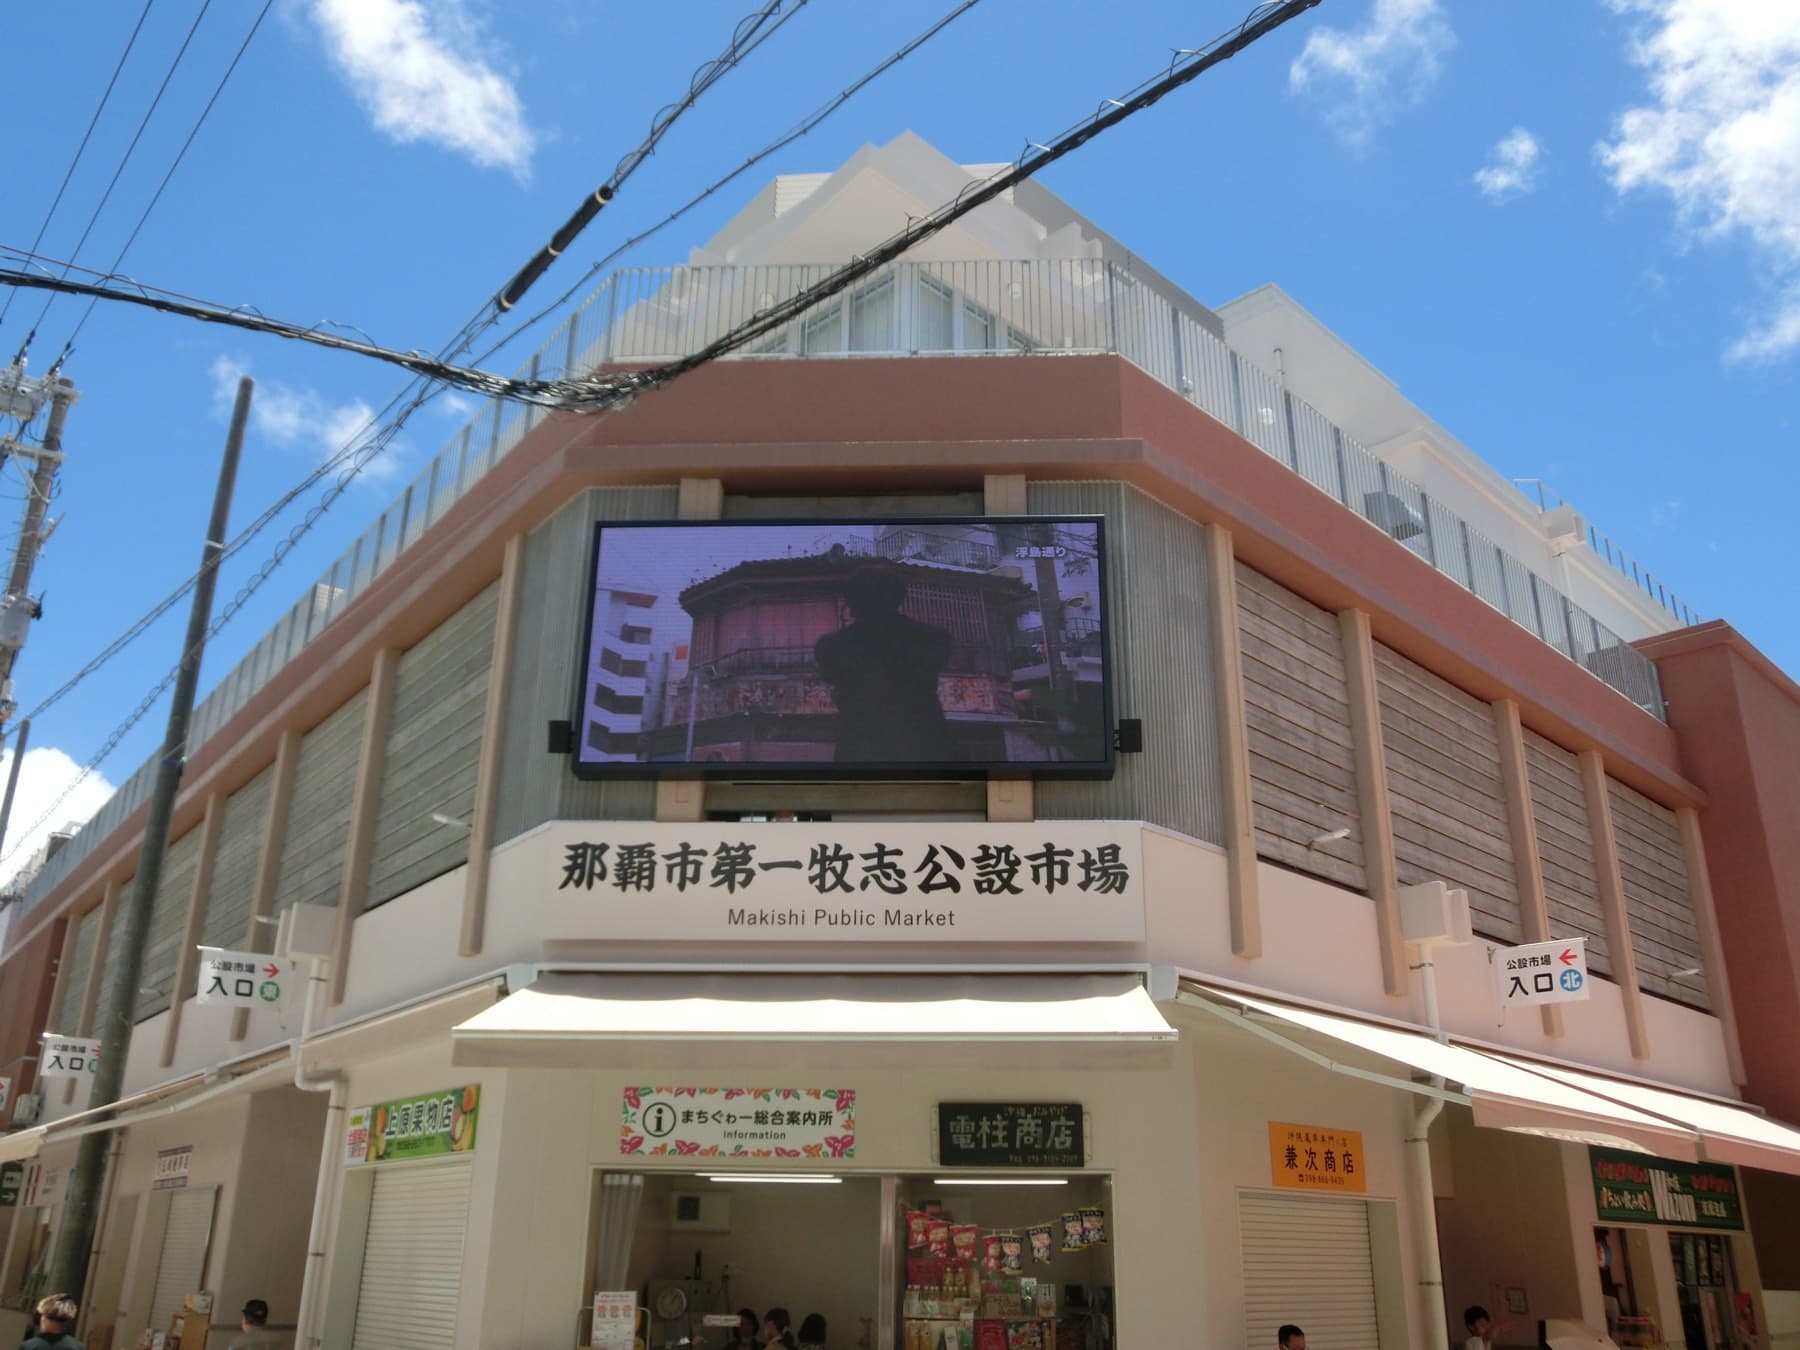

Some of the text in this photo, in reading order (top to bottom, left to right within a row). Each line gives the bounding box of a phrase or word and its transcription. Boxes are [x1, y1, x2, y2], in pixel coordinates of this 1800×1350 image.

[558, 842, 1130, 895] 那覇市第一牧志公設市場
[728, 908, 955, 926] Makishi Public Market
[210, 960, 256, 973] 公設市場
[1506, 954, 1552, 970] 公設市場
[206, 976, 254, 998] 入口
[1508, 971, 1581, 998] 入口 北
[48, 1055, 84, 1071] 入口
[384, 1095, 454, 1138] 上原果物店
[949, 1113, 1075, 1149] 電柱商店
[1285, 1144, 1354, 1174] 兼次商店
